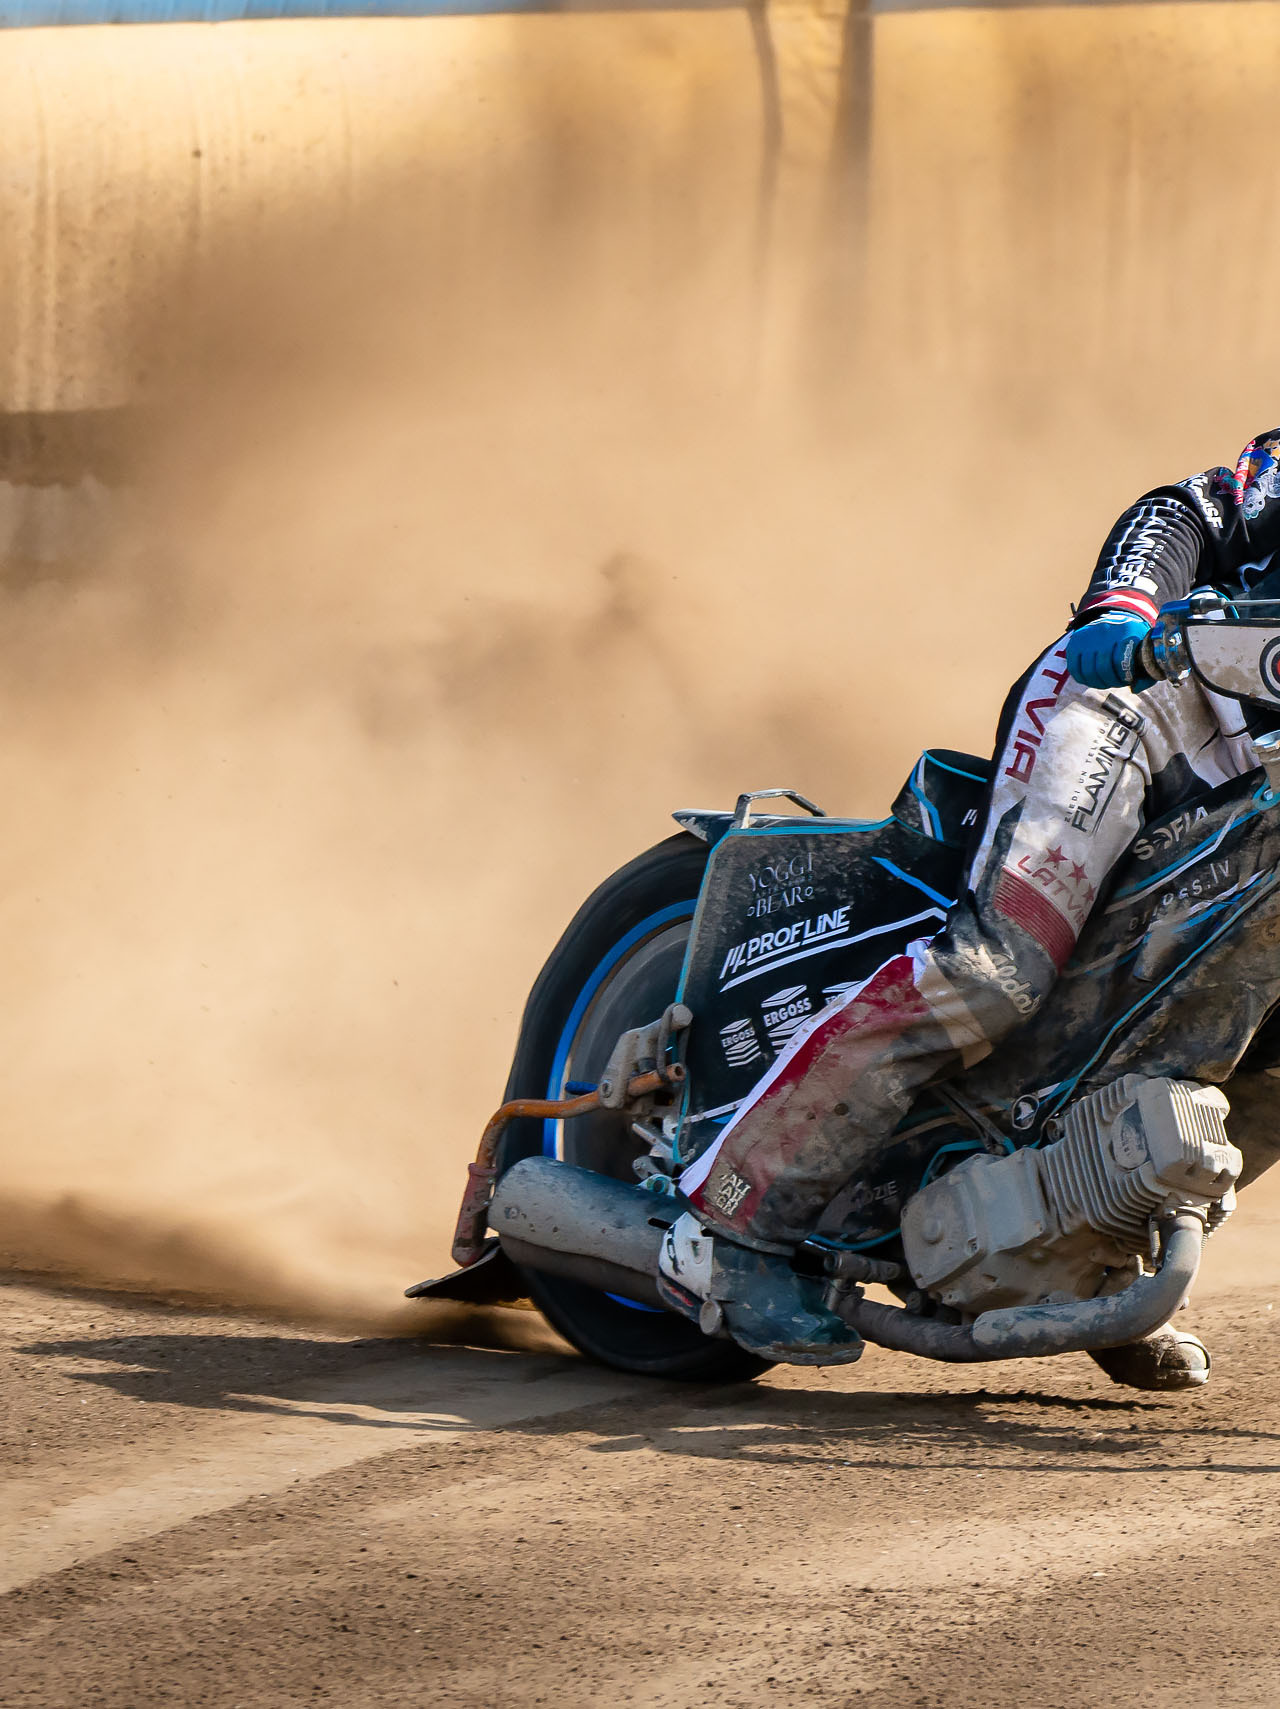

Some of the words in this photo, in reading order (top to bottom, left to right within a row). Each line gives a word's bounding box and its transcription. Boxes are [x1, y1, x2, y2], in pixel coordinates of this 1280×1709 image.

[1005, 650, 1070, 784] TVIA
[763, 997, 812, 1028] ERGOSS
[722, 1027, 755, 1048] ERGOSS
